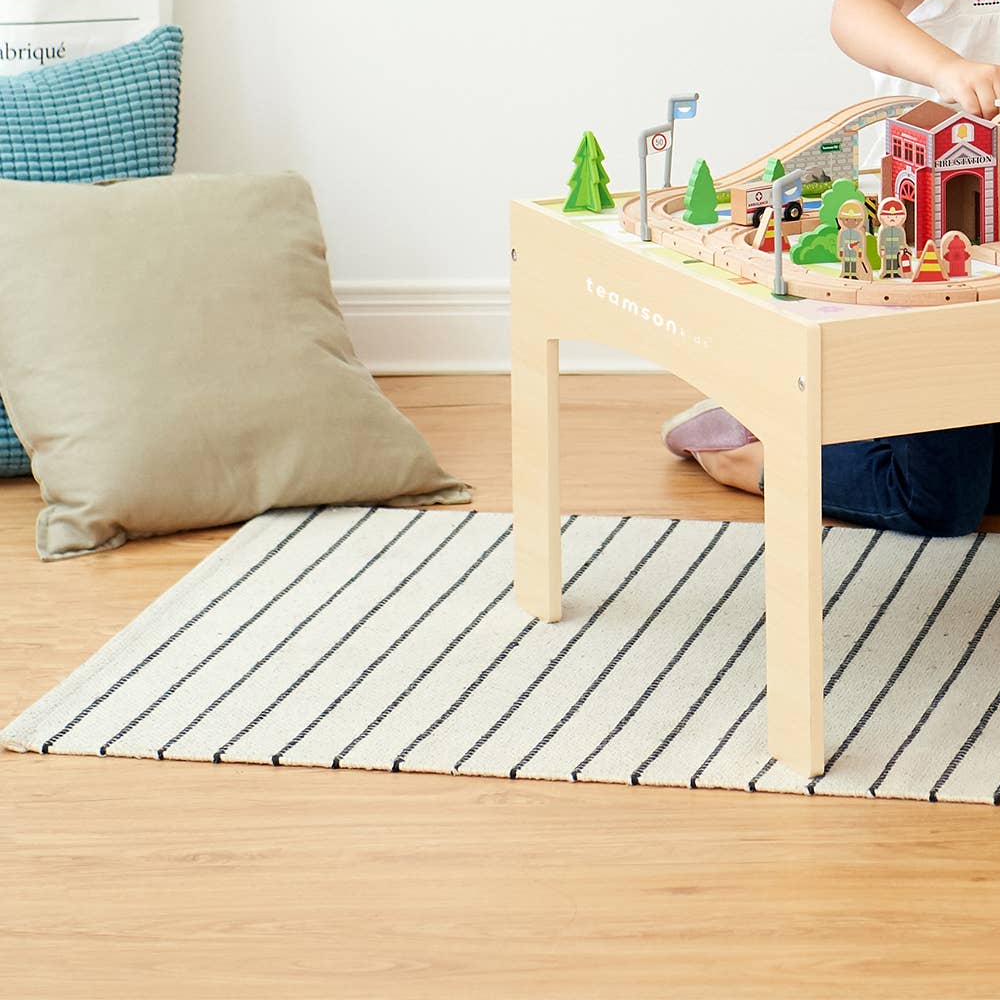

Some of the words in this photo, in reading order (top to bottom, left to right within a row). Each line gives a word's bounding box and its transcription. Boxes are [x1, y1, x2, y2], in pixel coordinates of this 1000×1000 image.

[0, 41, 66, 65] briqué
[934, 159, 952, 168] FIRE
[955, 155, 992, 166] STATION
[585, 276, 677, 336] teamson
